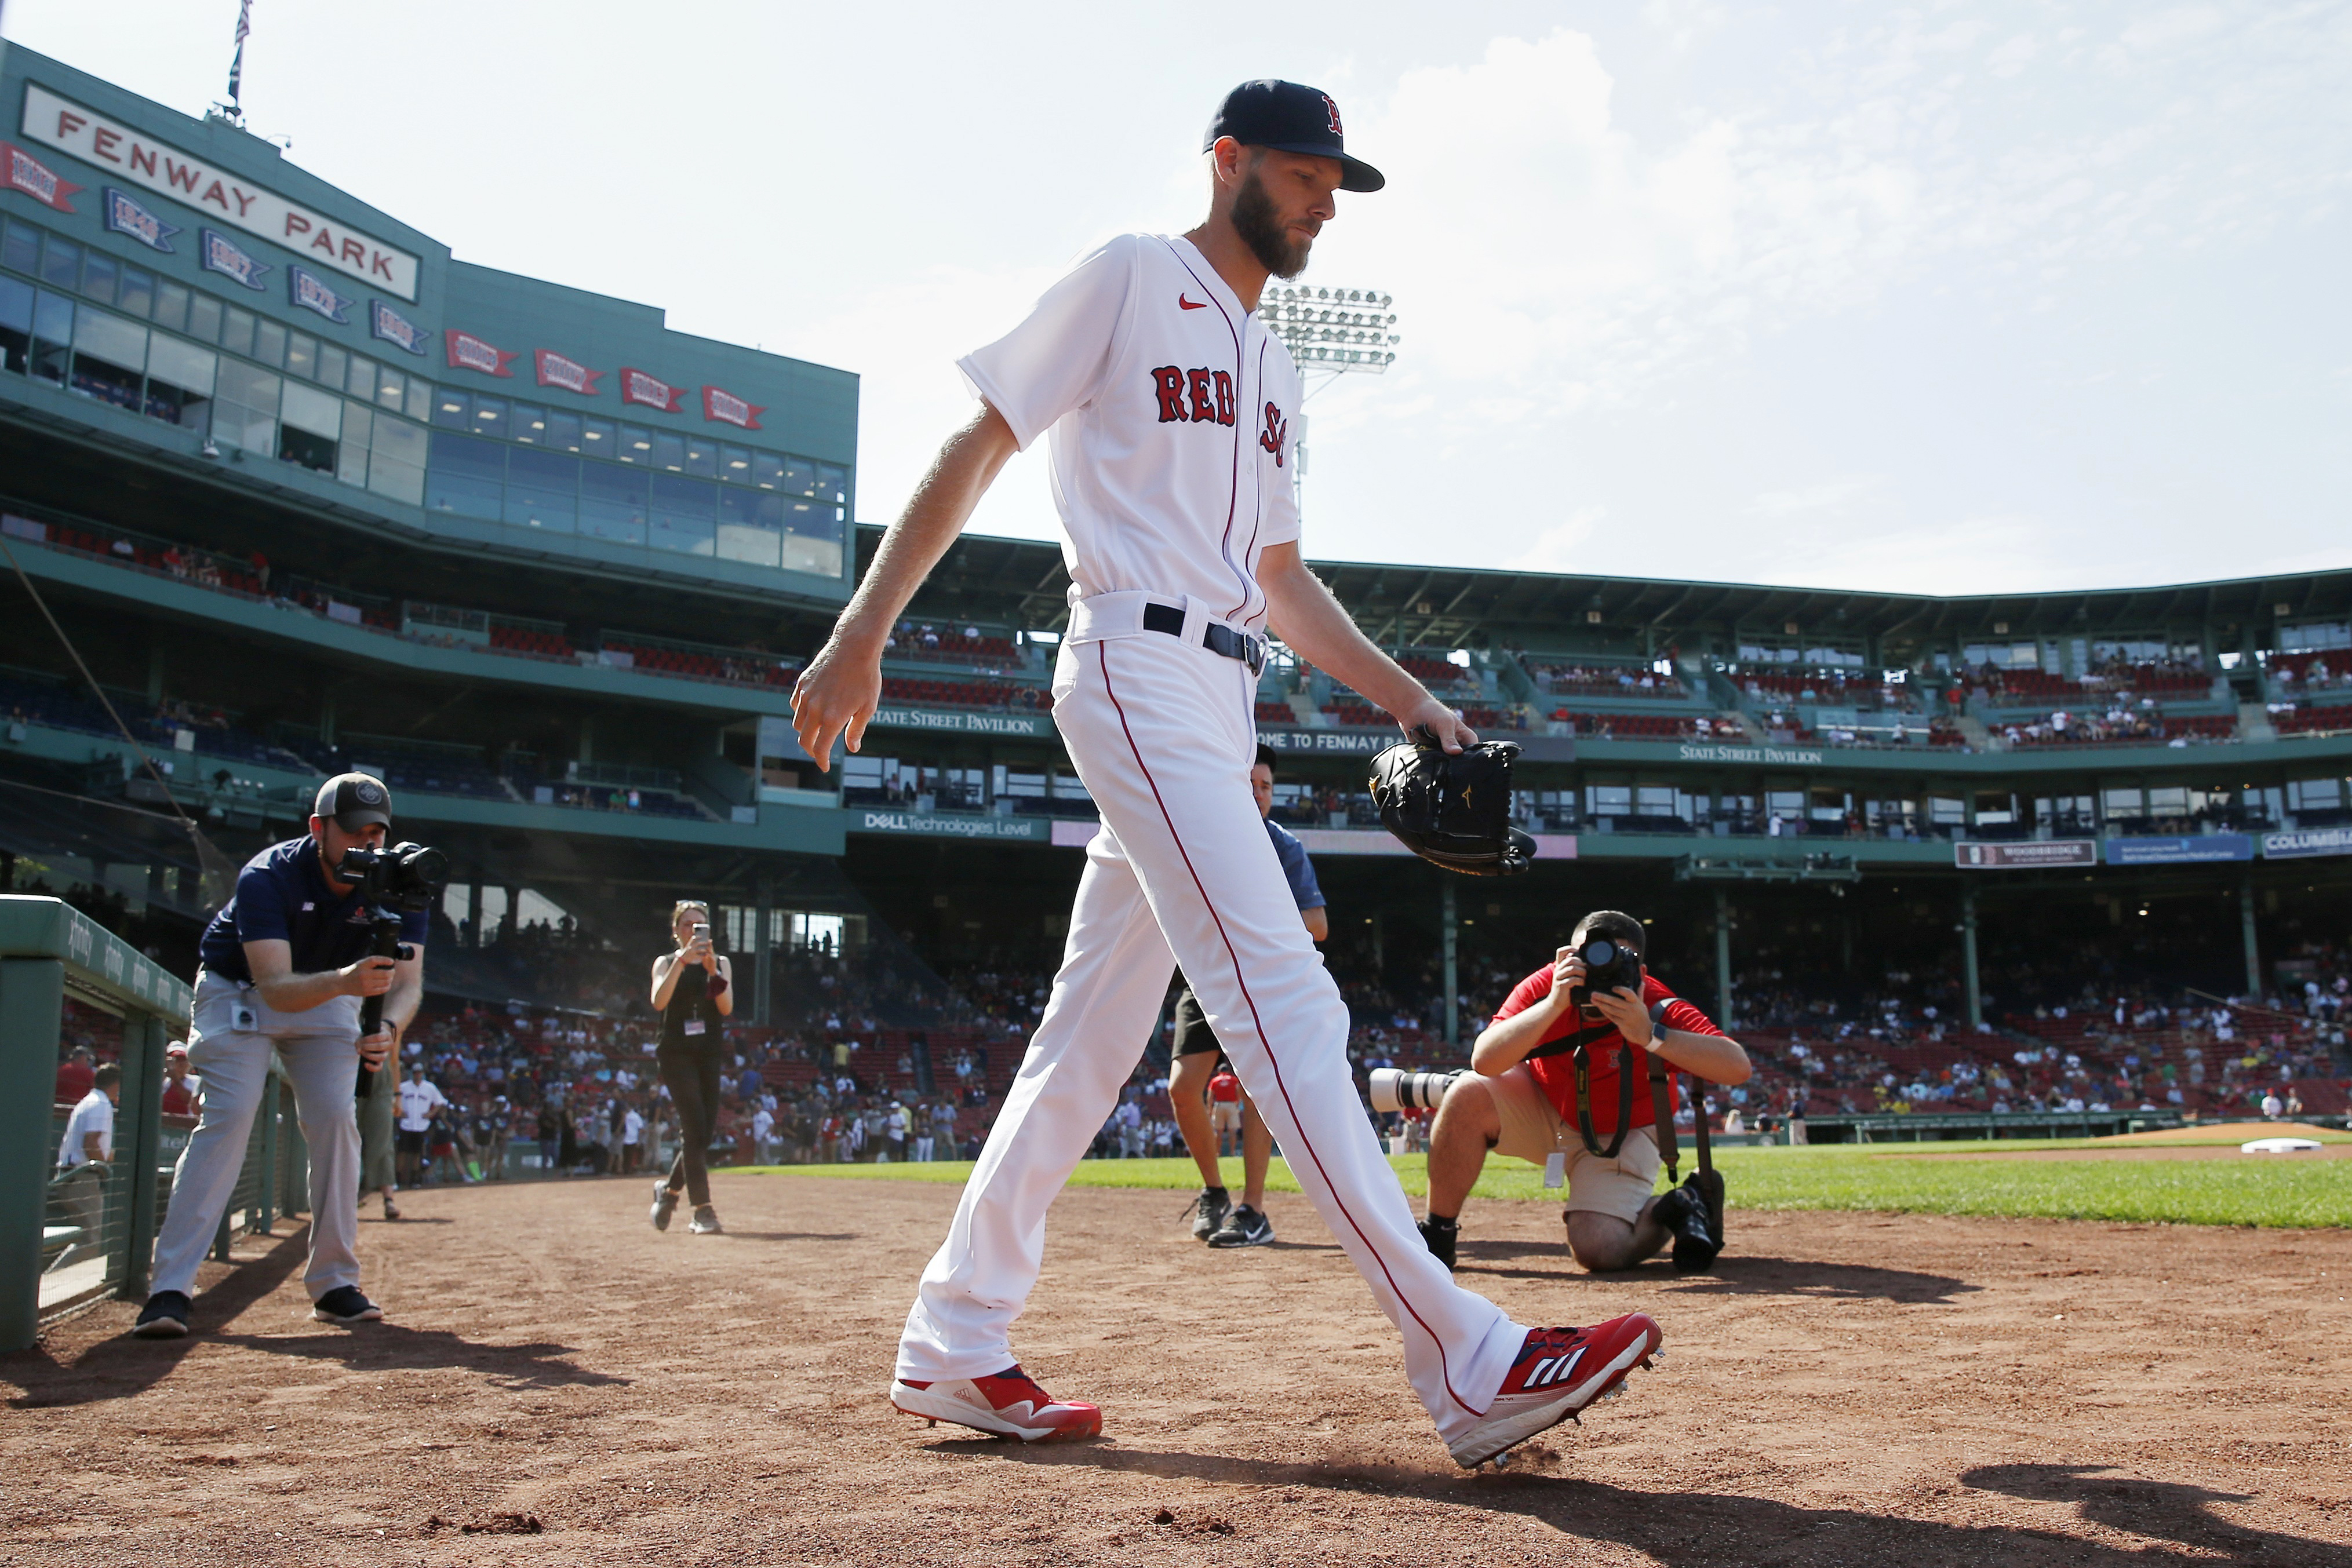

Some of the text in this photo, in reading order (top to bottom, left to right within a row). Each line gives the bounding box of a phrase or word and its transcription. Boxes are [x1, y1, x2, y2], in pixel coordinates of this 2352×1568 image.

[59, 110, 393, 282] FENWAY PARK
[1150, 365, 1236, 427] RED
[910, 710, 962, 728] STREET
[966, 714, 1035, 734] PAVILION
[1291, 734, 1312, 747] TO
[1316, 735, 1379, 750] FENWAY
[1680, 745, 1822, 763] STATE STREET PAVILION
[865, 814, 1031, 837] DELL Technologies Level
